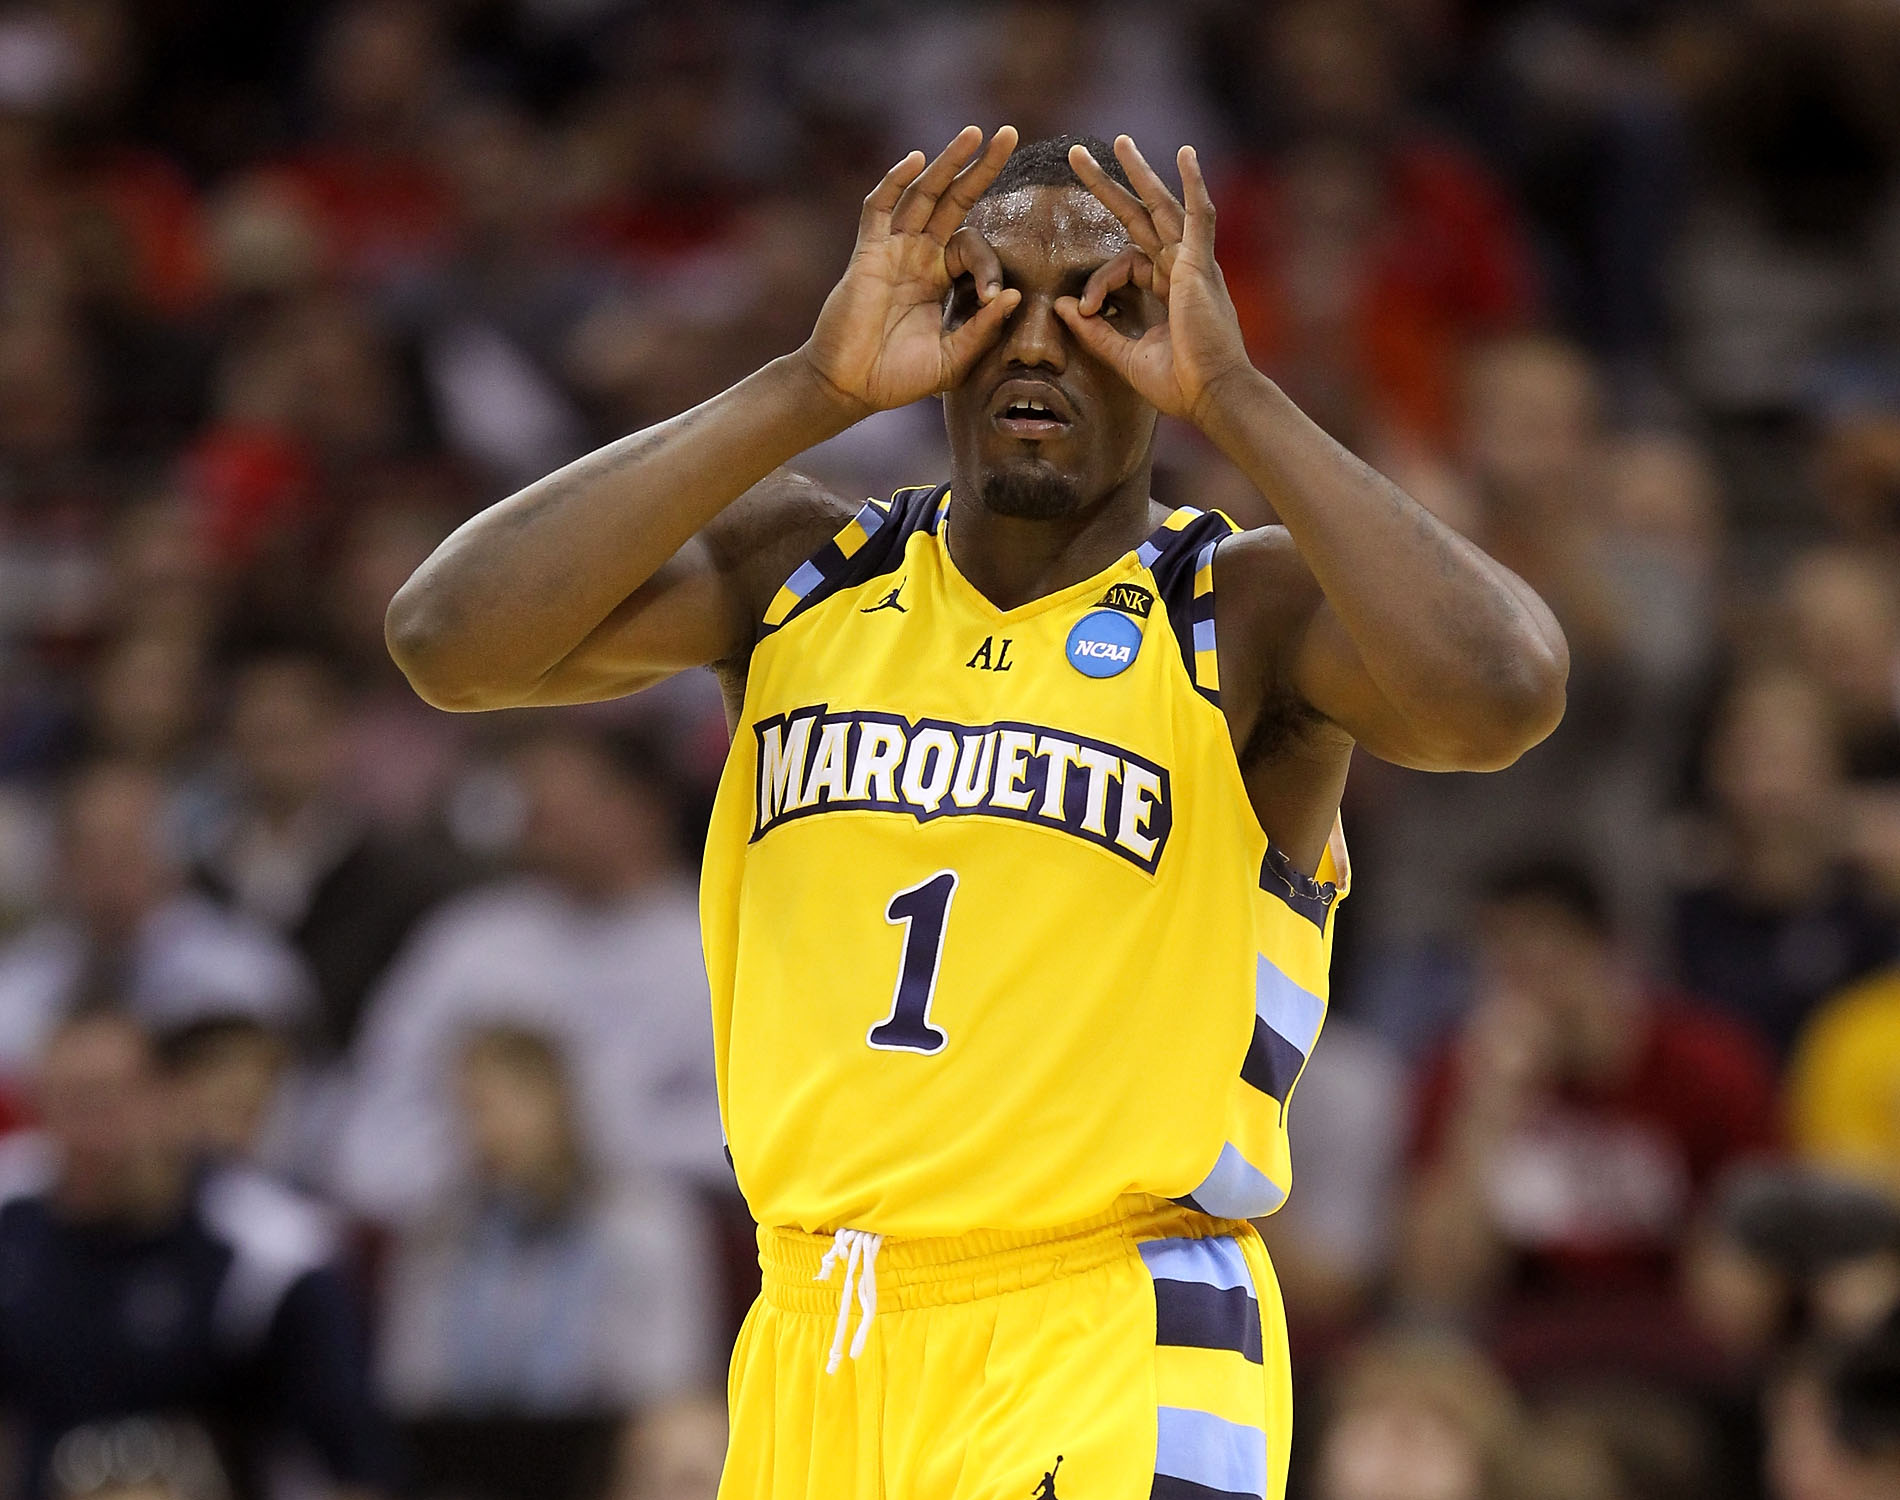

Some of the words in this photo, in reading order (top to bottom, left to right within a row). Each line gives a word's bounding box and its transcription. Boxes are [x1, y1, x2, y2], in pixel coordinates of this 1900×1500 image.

[966, 635, 1013, 672] AL
[1074, 640, 1131, 663] NCAA
[759, 715, 1163, 862] MARQUETTE
[866, 868, 959, 1056] 1
